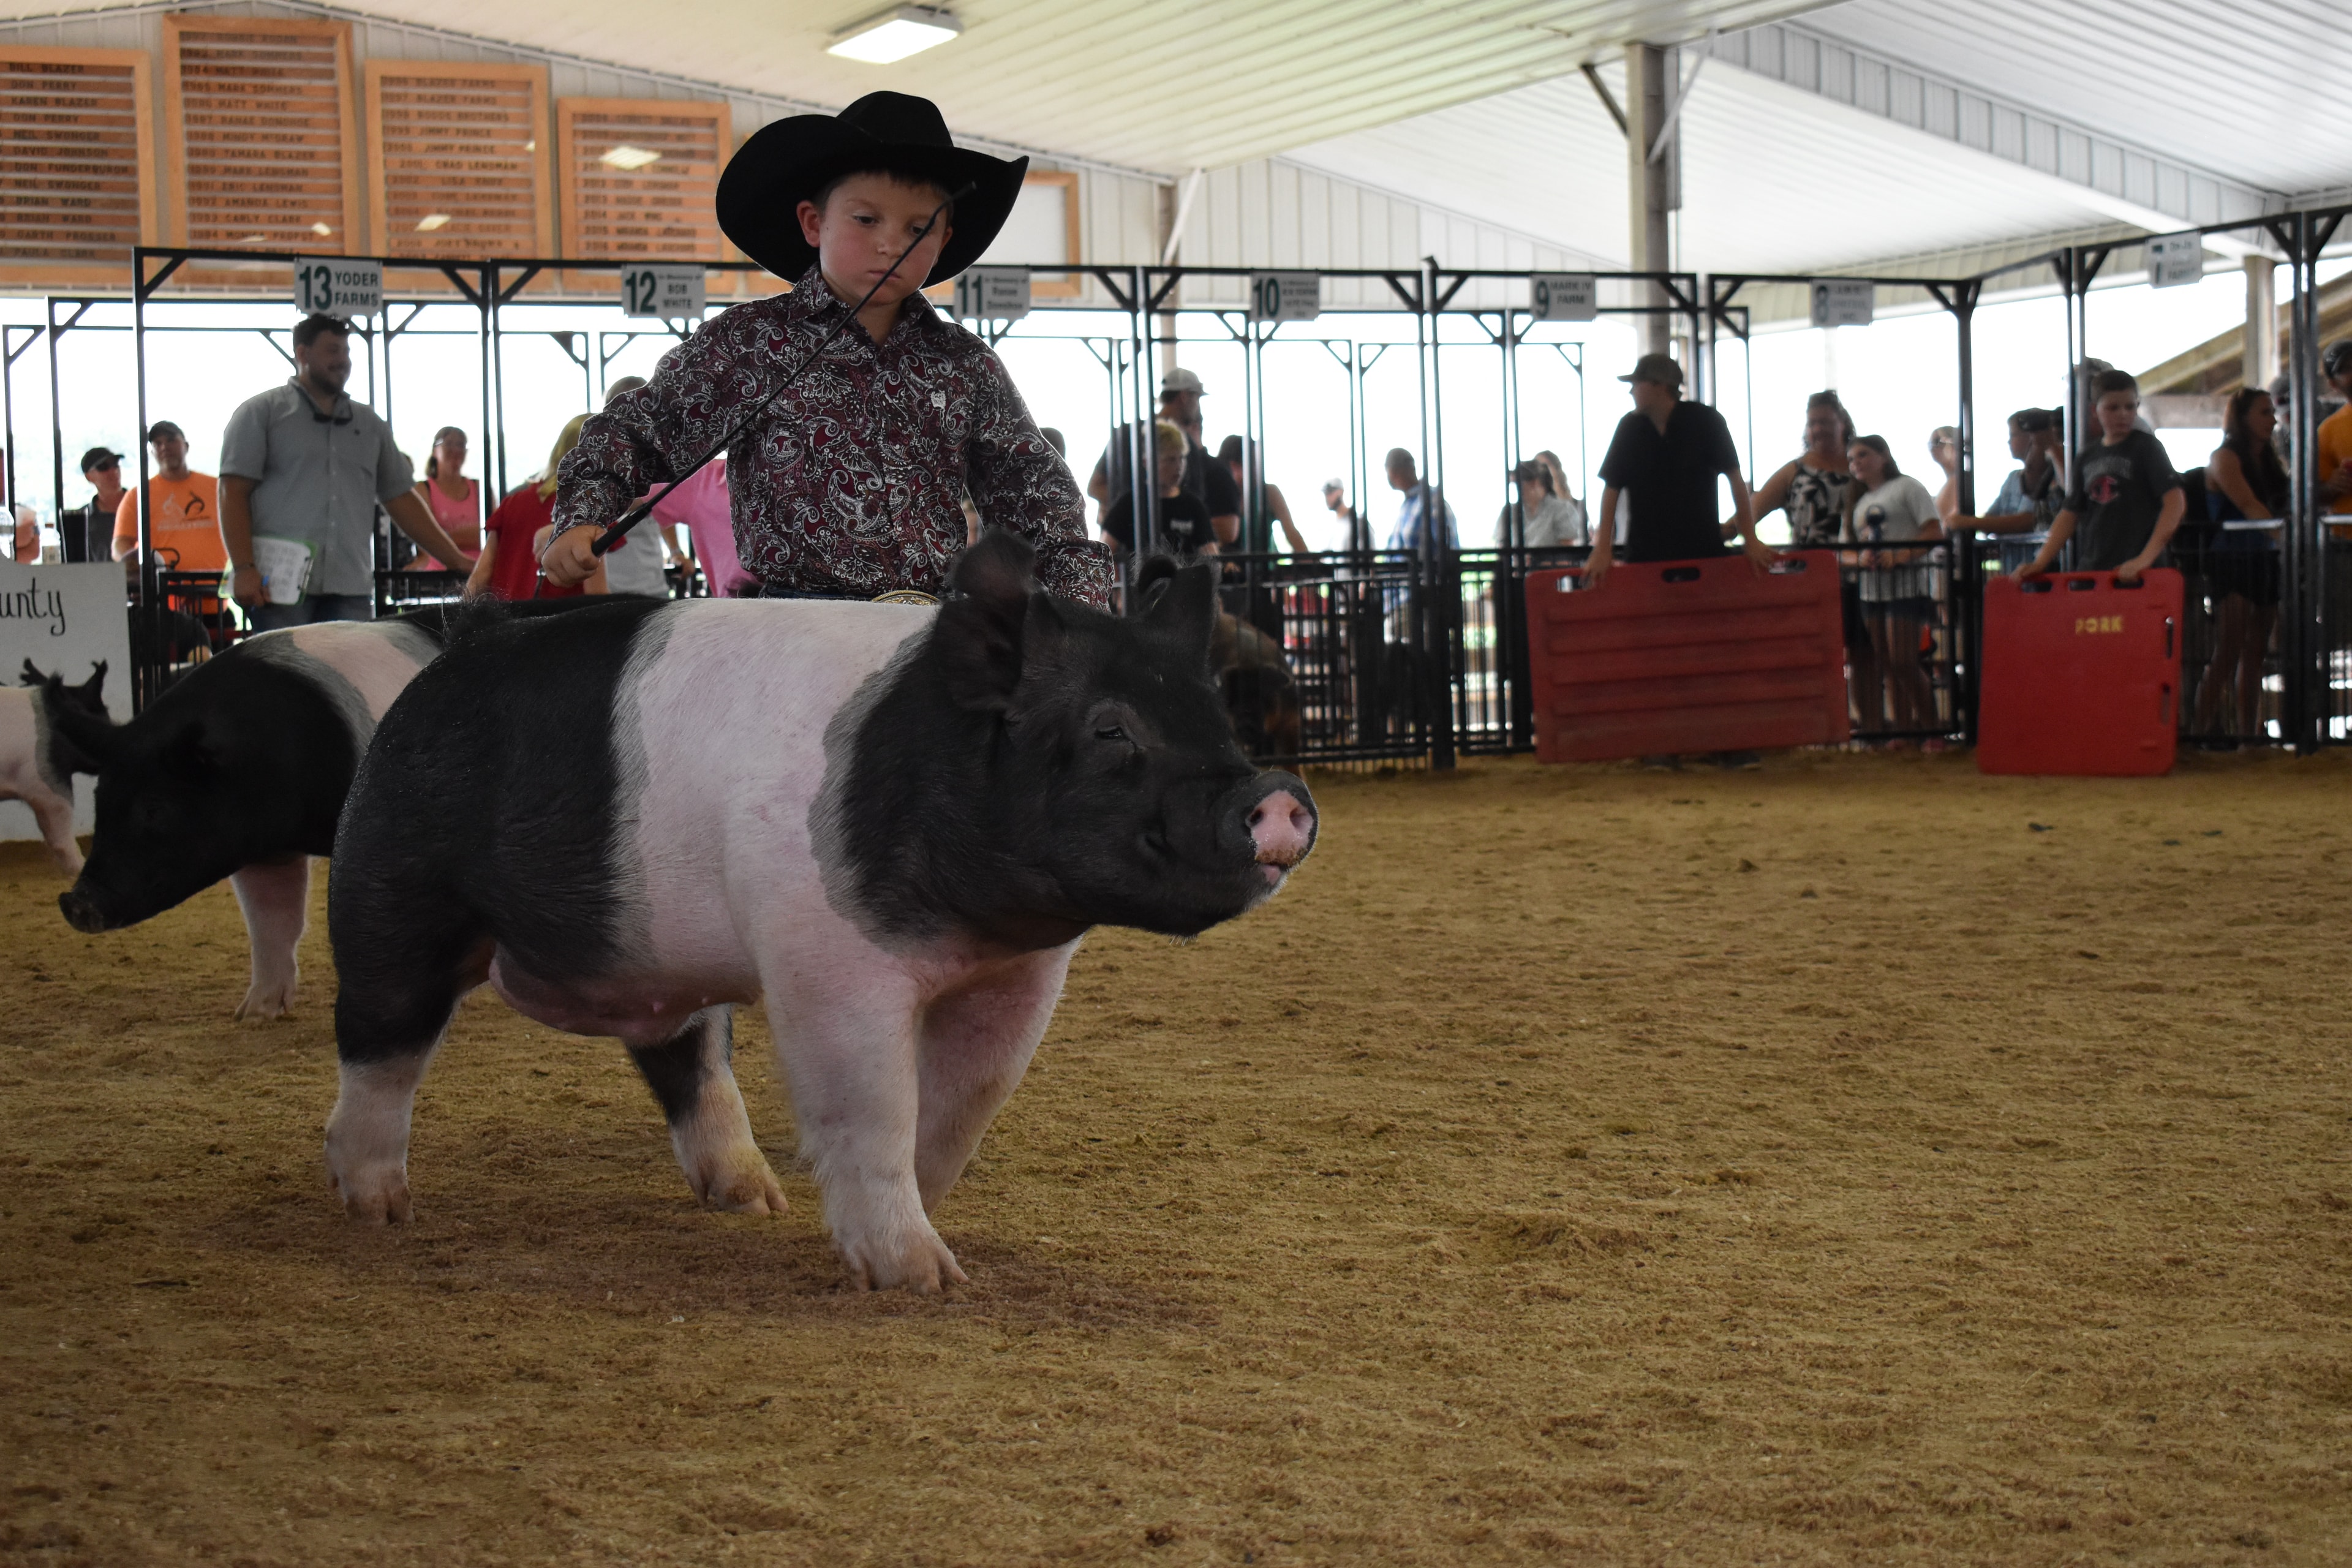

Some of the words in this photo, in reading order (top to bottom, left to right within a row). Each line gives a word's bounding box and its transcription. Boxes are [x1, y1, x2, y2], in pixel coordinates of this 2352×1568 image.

[335, 271, 379, 286] YODER
[1550, 281, 1580, 291] MARK
[299, 266, 332, 311] 13
[625, 271, 657, 314] 12
[668, 284, 687, 295] BOB
[957, 274, 982, 315] 11
[1253, 277, 1280, 318] 10
[335, 292, 379, 307] FARMS
[663, 298, 692, 309] WHITE
[1535, 279, 1551, 320] 9
[1556, 294, 1585, 304] FARM
[2075, 615, 2124, 636] PORK
